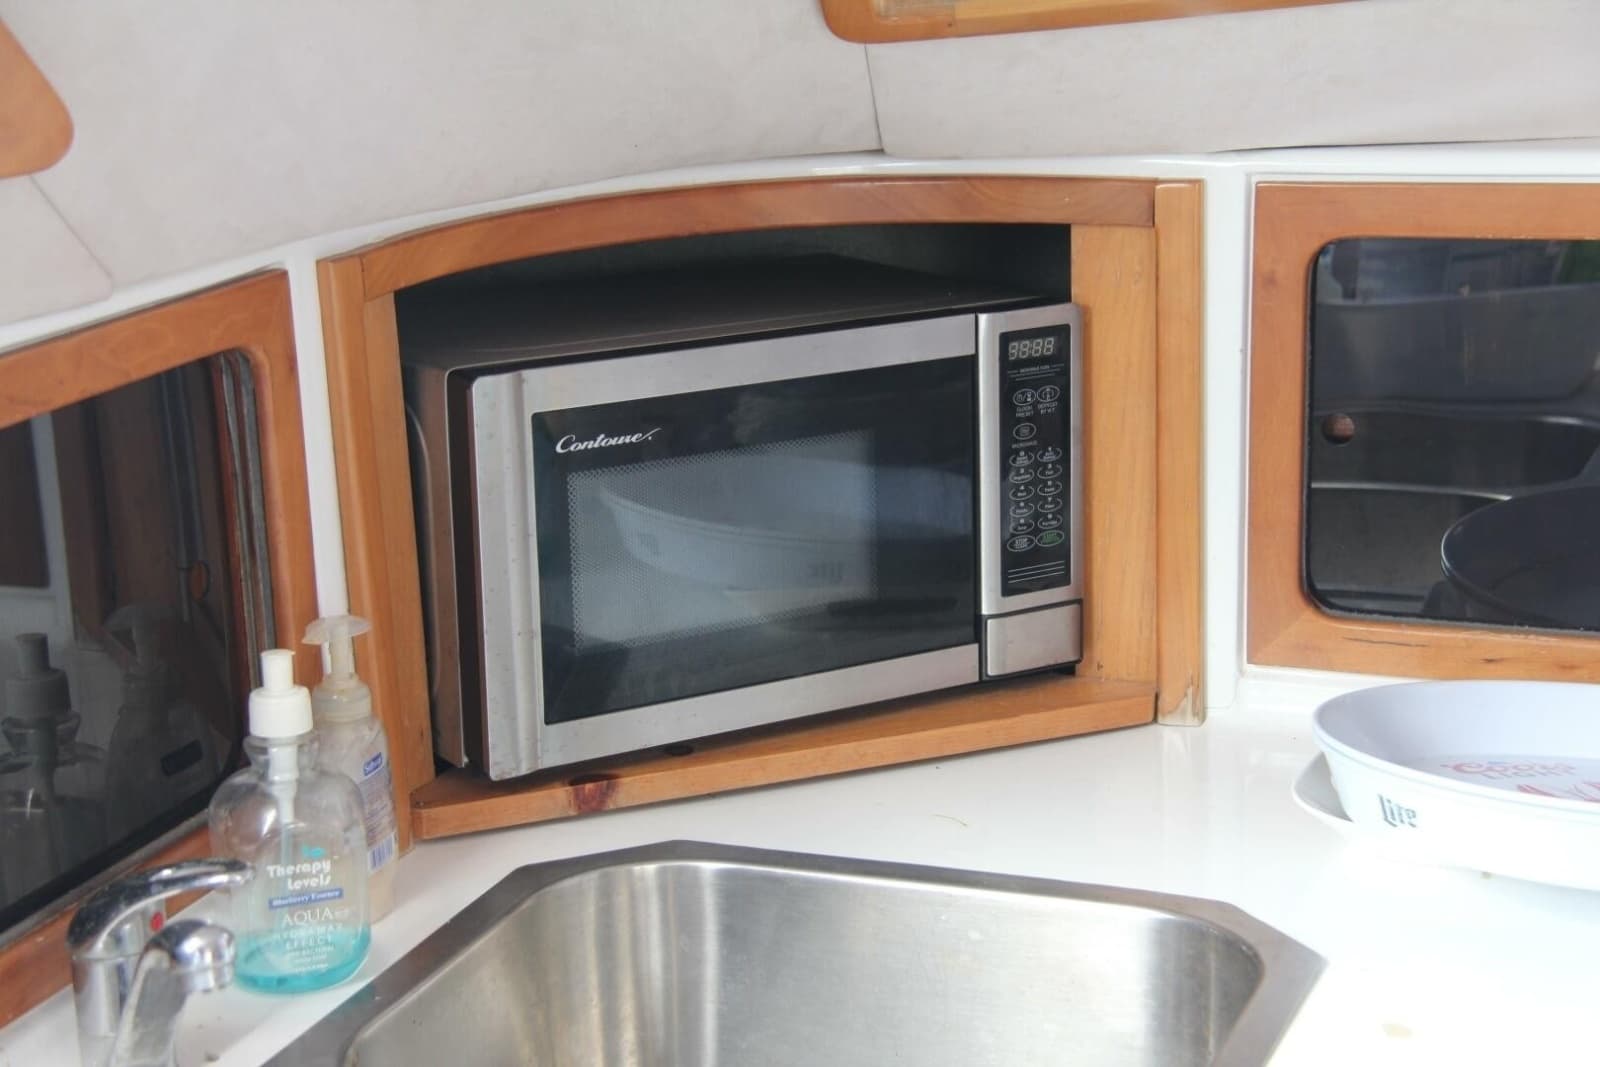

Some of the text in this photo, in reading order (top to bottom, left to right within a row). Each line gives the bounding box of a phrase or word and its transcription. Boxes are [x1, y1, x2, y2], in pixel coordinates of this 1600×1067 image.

[266, 859, 331, 879] Therapy
[287, 873, 332, 891] Levels
[281, 906, 334, 929] AQUA
